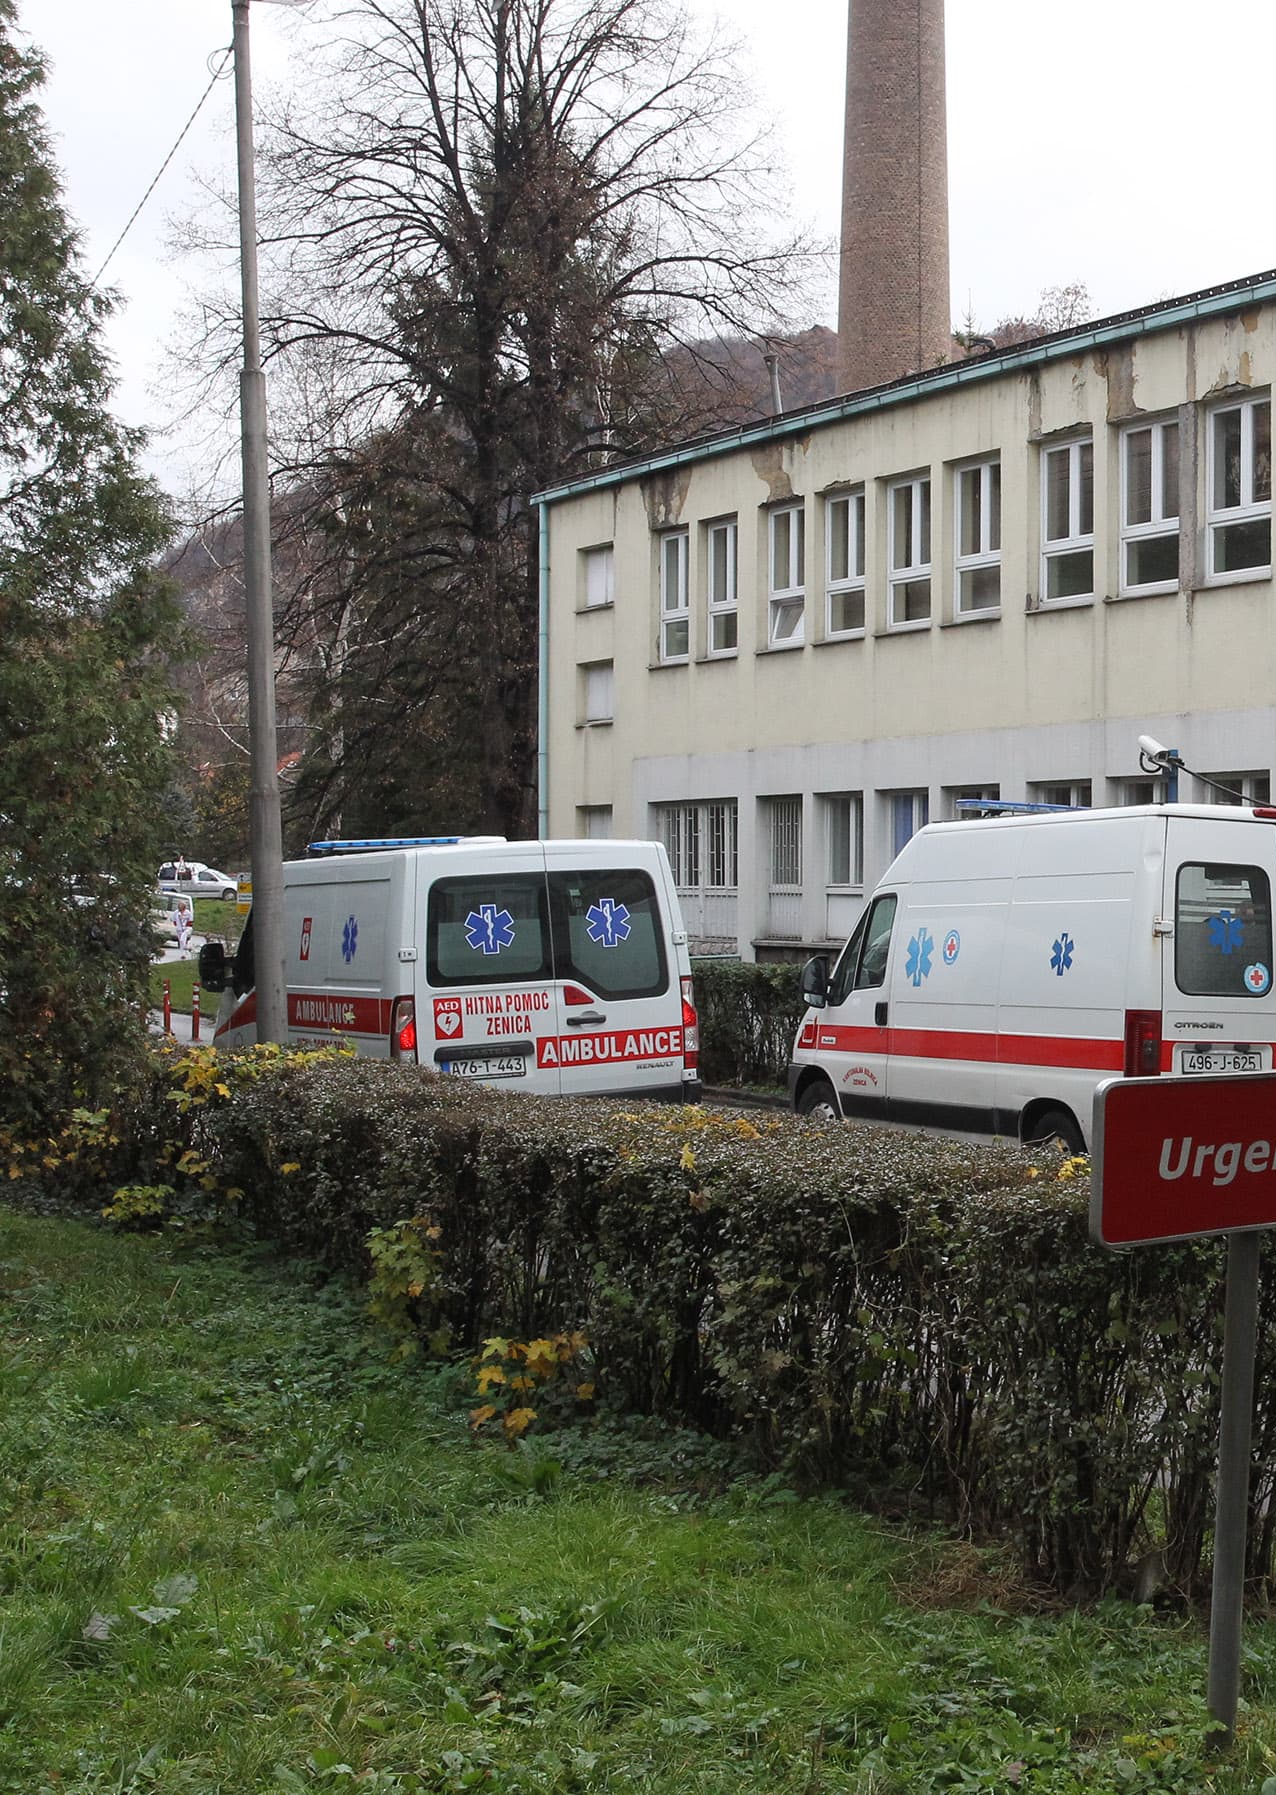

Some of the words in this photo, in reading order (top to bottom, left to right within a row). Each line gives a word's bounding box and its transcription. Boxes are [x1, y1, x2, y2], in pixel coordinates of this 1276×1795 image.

[296, 1000, 355, 1024] AMBULANCE
[436, 1001, 459, 1012] AED
[465, 994, 503, 1016] HITNA
[505, 989, 549, 1013] POMOĆ
[486, 1015, 532, 1036] ZENICA
[541, 1030, 681, 1064] AMBULANCE
[452, 1058, 522, 1075] A76-T-443
[1188, 1055, 1257, 1071] 496-J-625
